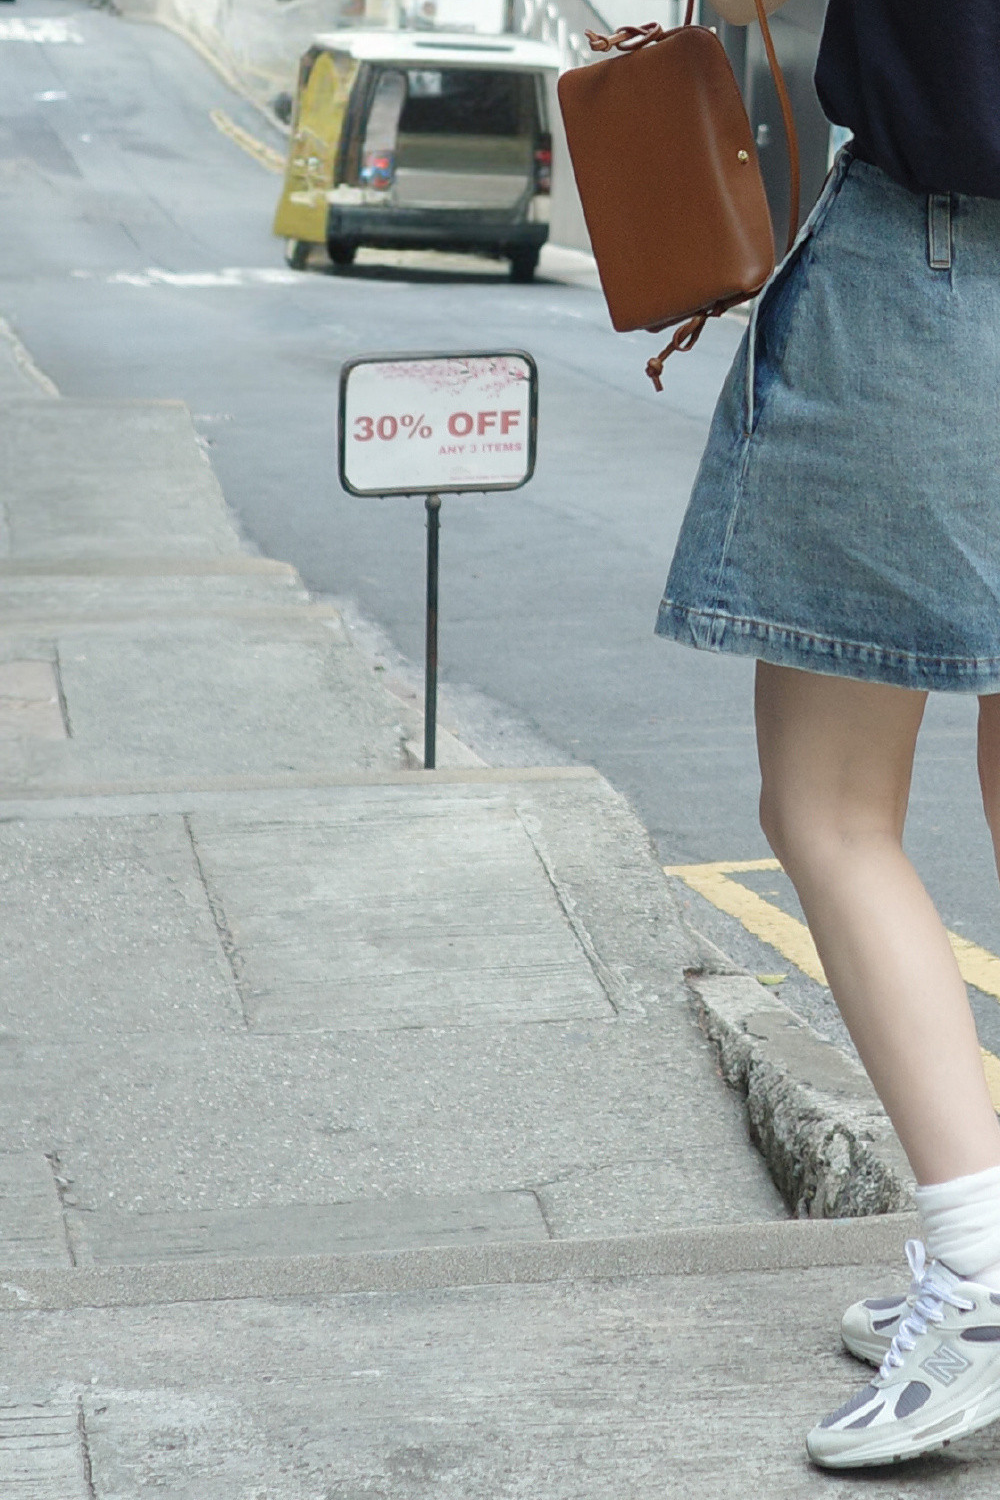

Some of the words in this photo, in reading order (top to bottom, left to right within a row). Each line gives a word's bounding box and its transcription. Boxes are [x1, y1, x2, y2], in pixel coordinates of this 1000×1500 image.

[353, 414, 433, 442] 30%
[447, 410, 521, 438] OFF
[438, 445, 464, 455] ANY
[482, 442, 522, 453] ITEMS
[919, 1342, 973, 1388] N
